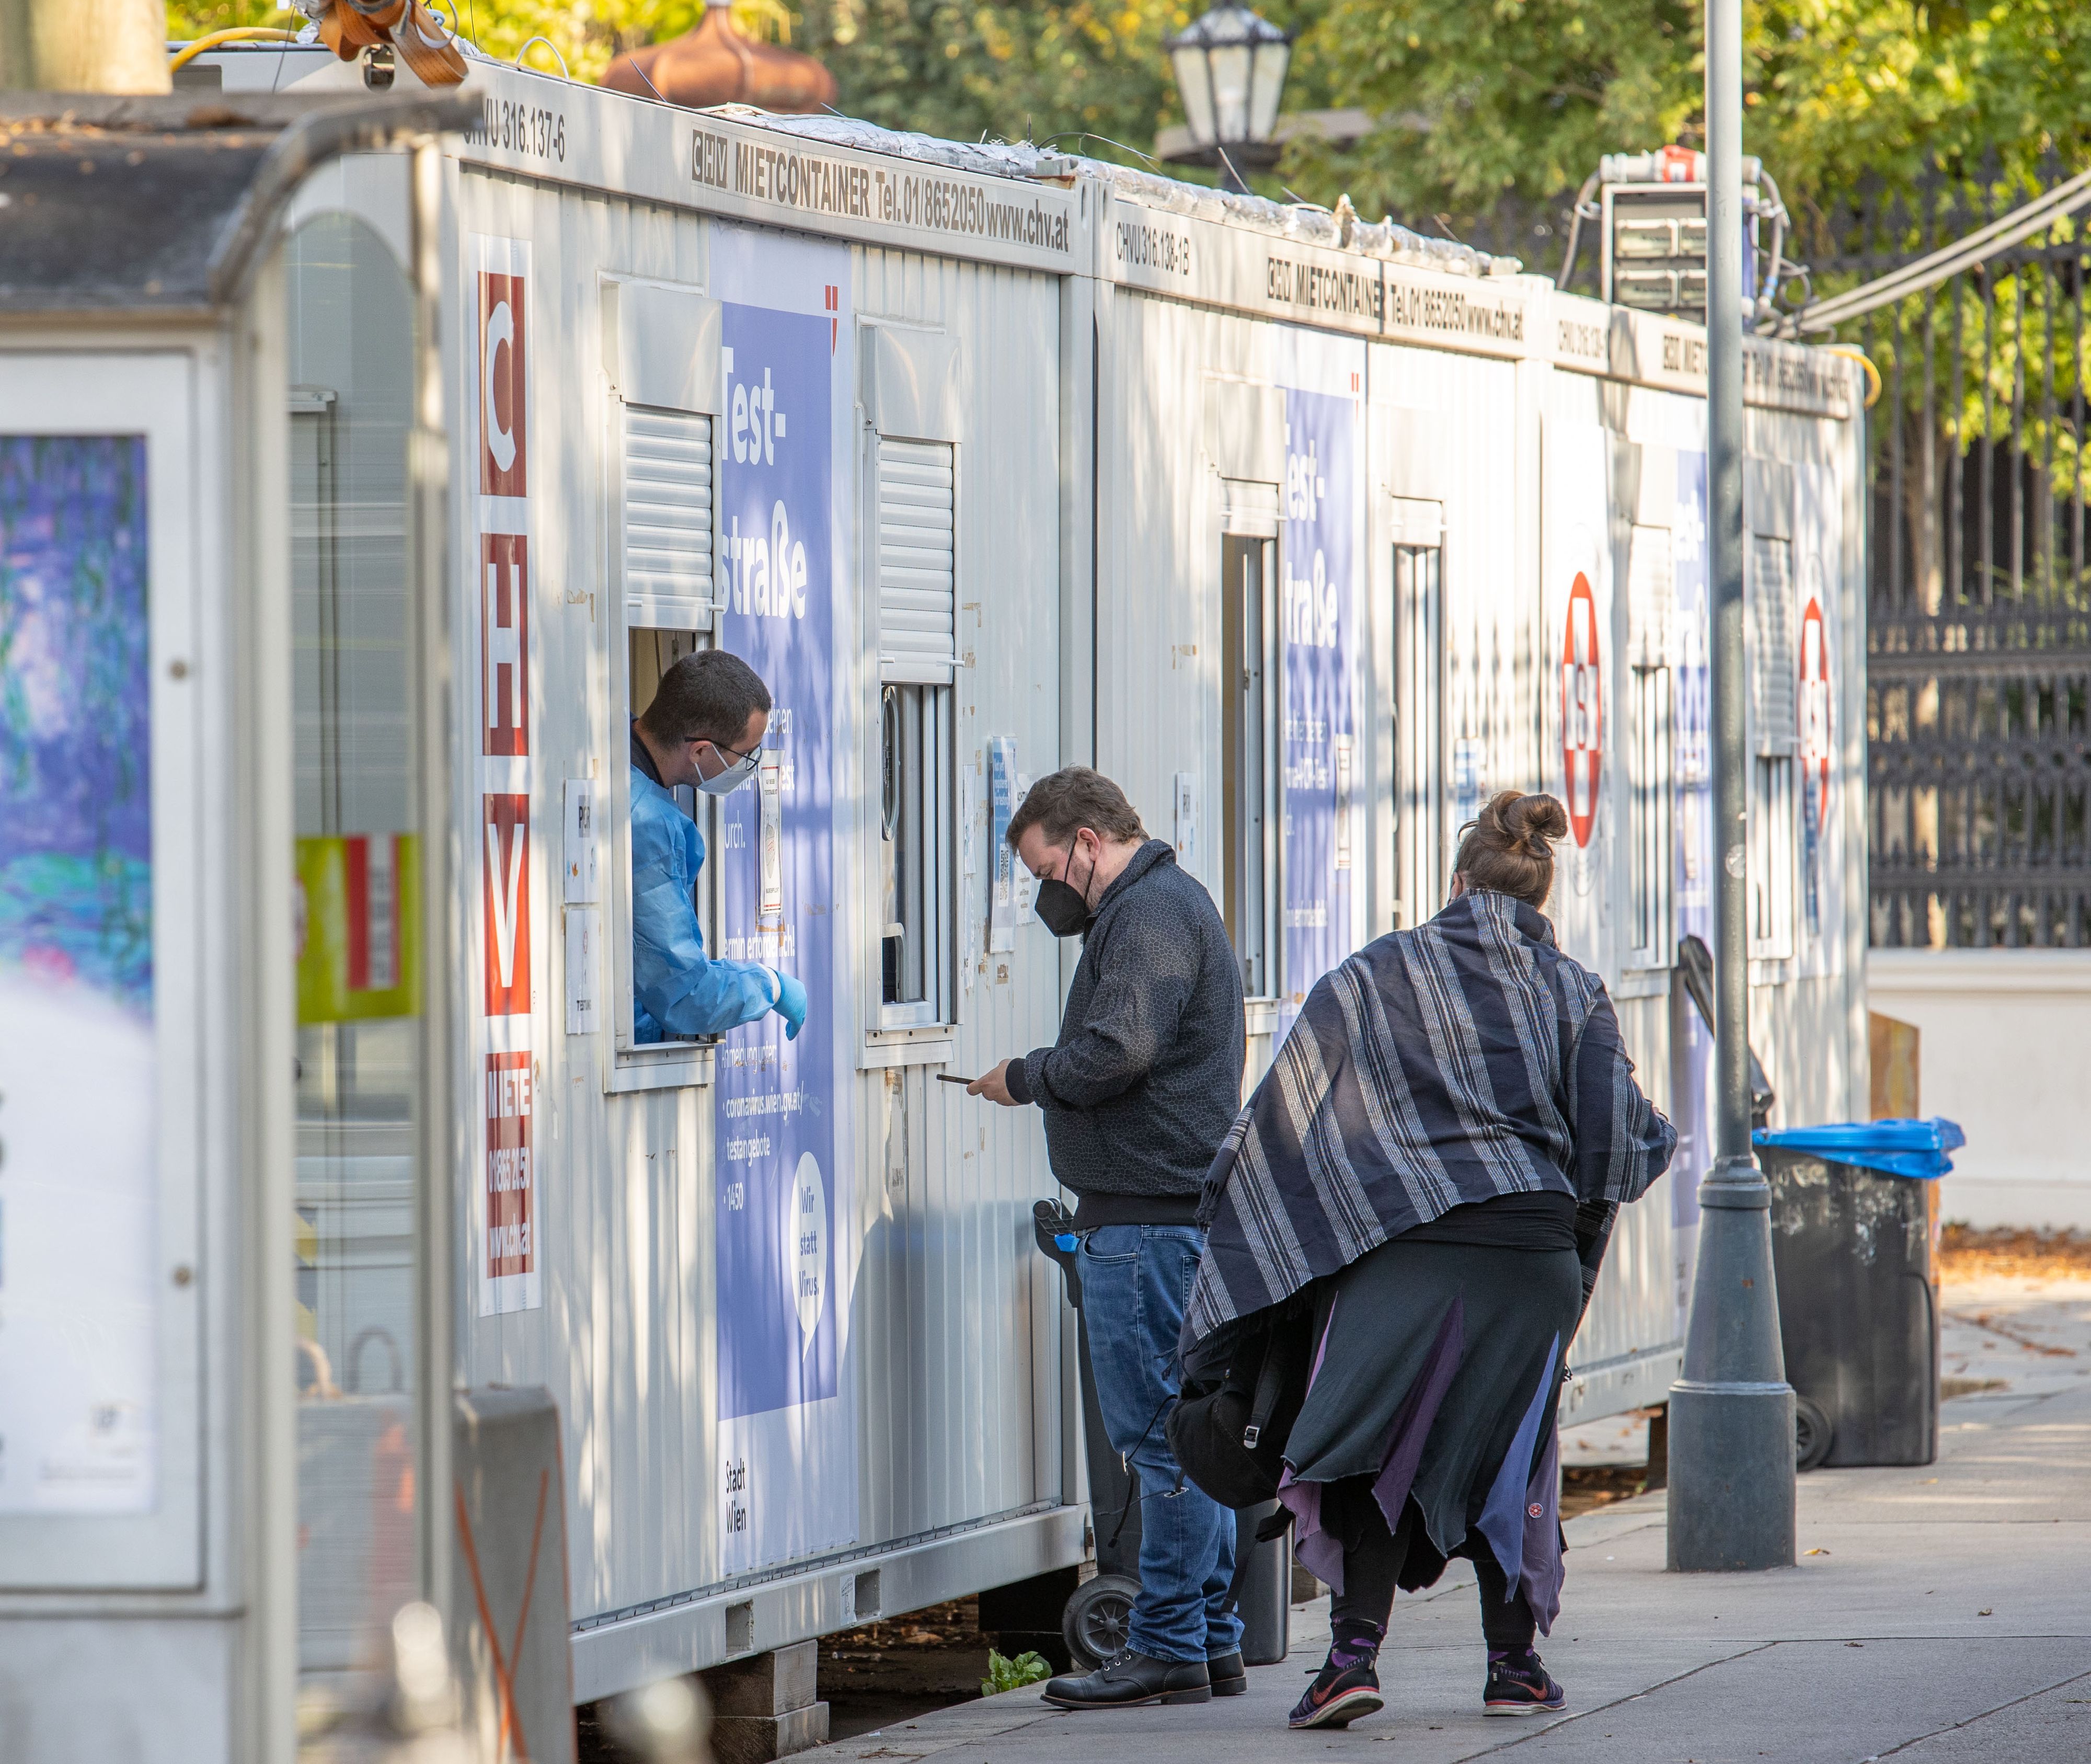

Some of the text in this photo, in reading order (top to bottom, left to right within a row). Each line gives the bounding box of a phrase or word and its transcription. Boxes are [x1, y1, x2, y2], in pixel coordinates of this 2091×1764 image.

[503, 99, 565, 163] 316.137-6
[692, 129, 1069, 253] CHV MIETCONTAINER Tel. 01/8652050 www.chv.at
[1116, 221, 1140, 265] CHVU
[722, 346, 786, 466] Test-
[1285, 422, 1325, 522] est-
[1285, 548, 1338, 649] traße
[764, 698, 792, 735] einen
[725, 809, 745, 849] urch.
[725, 927, 745, 960] ermin
[726, 1080, 804, 1120] coronavirus.wien.gv.at/
[726, 1129, 771, 1167] testangebote
[727, 1182, 743, 1211] 1450
[801, 1185, 814, 1213] Wir
[800, 1230, 818, 1256] statt
[798, 1270, 820, 1298] Virus.
[726, 1458, 745, 1494] Stadt
[726, 1499, 746, 1534] Wien
